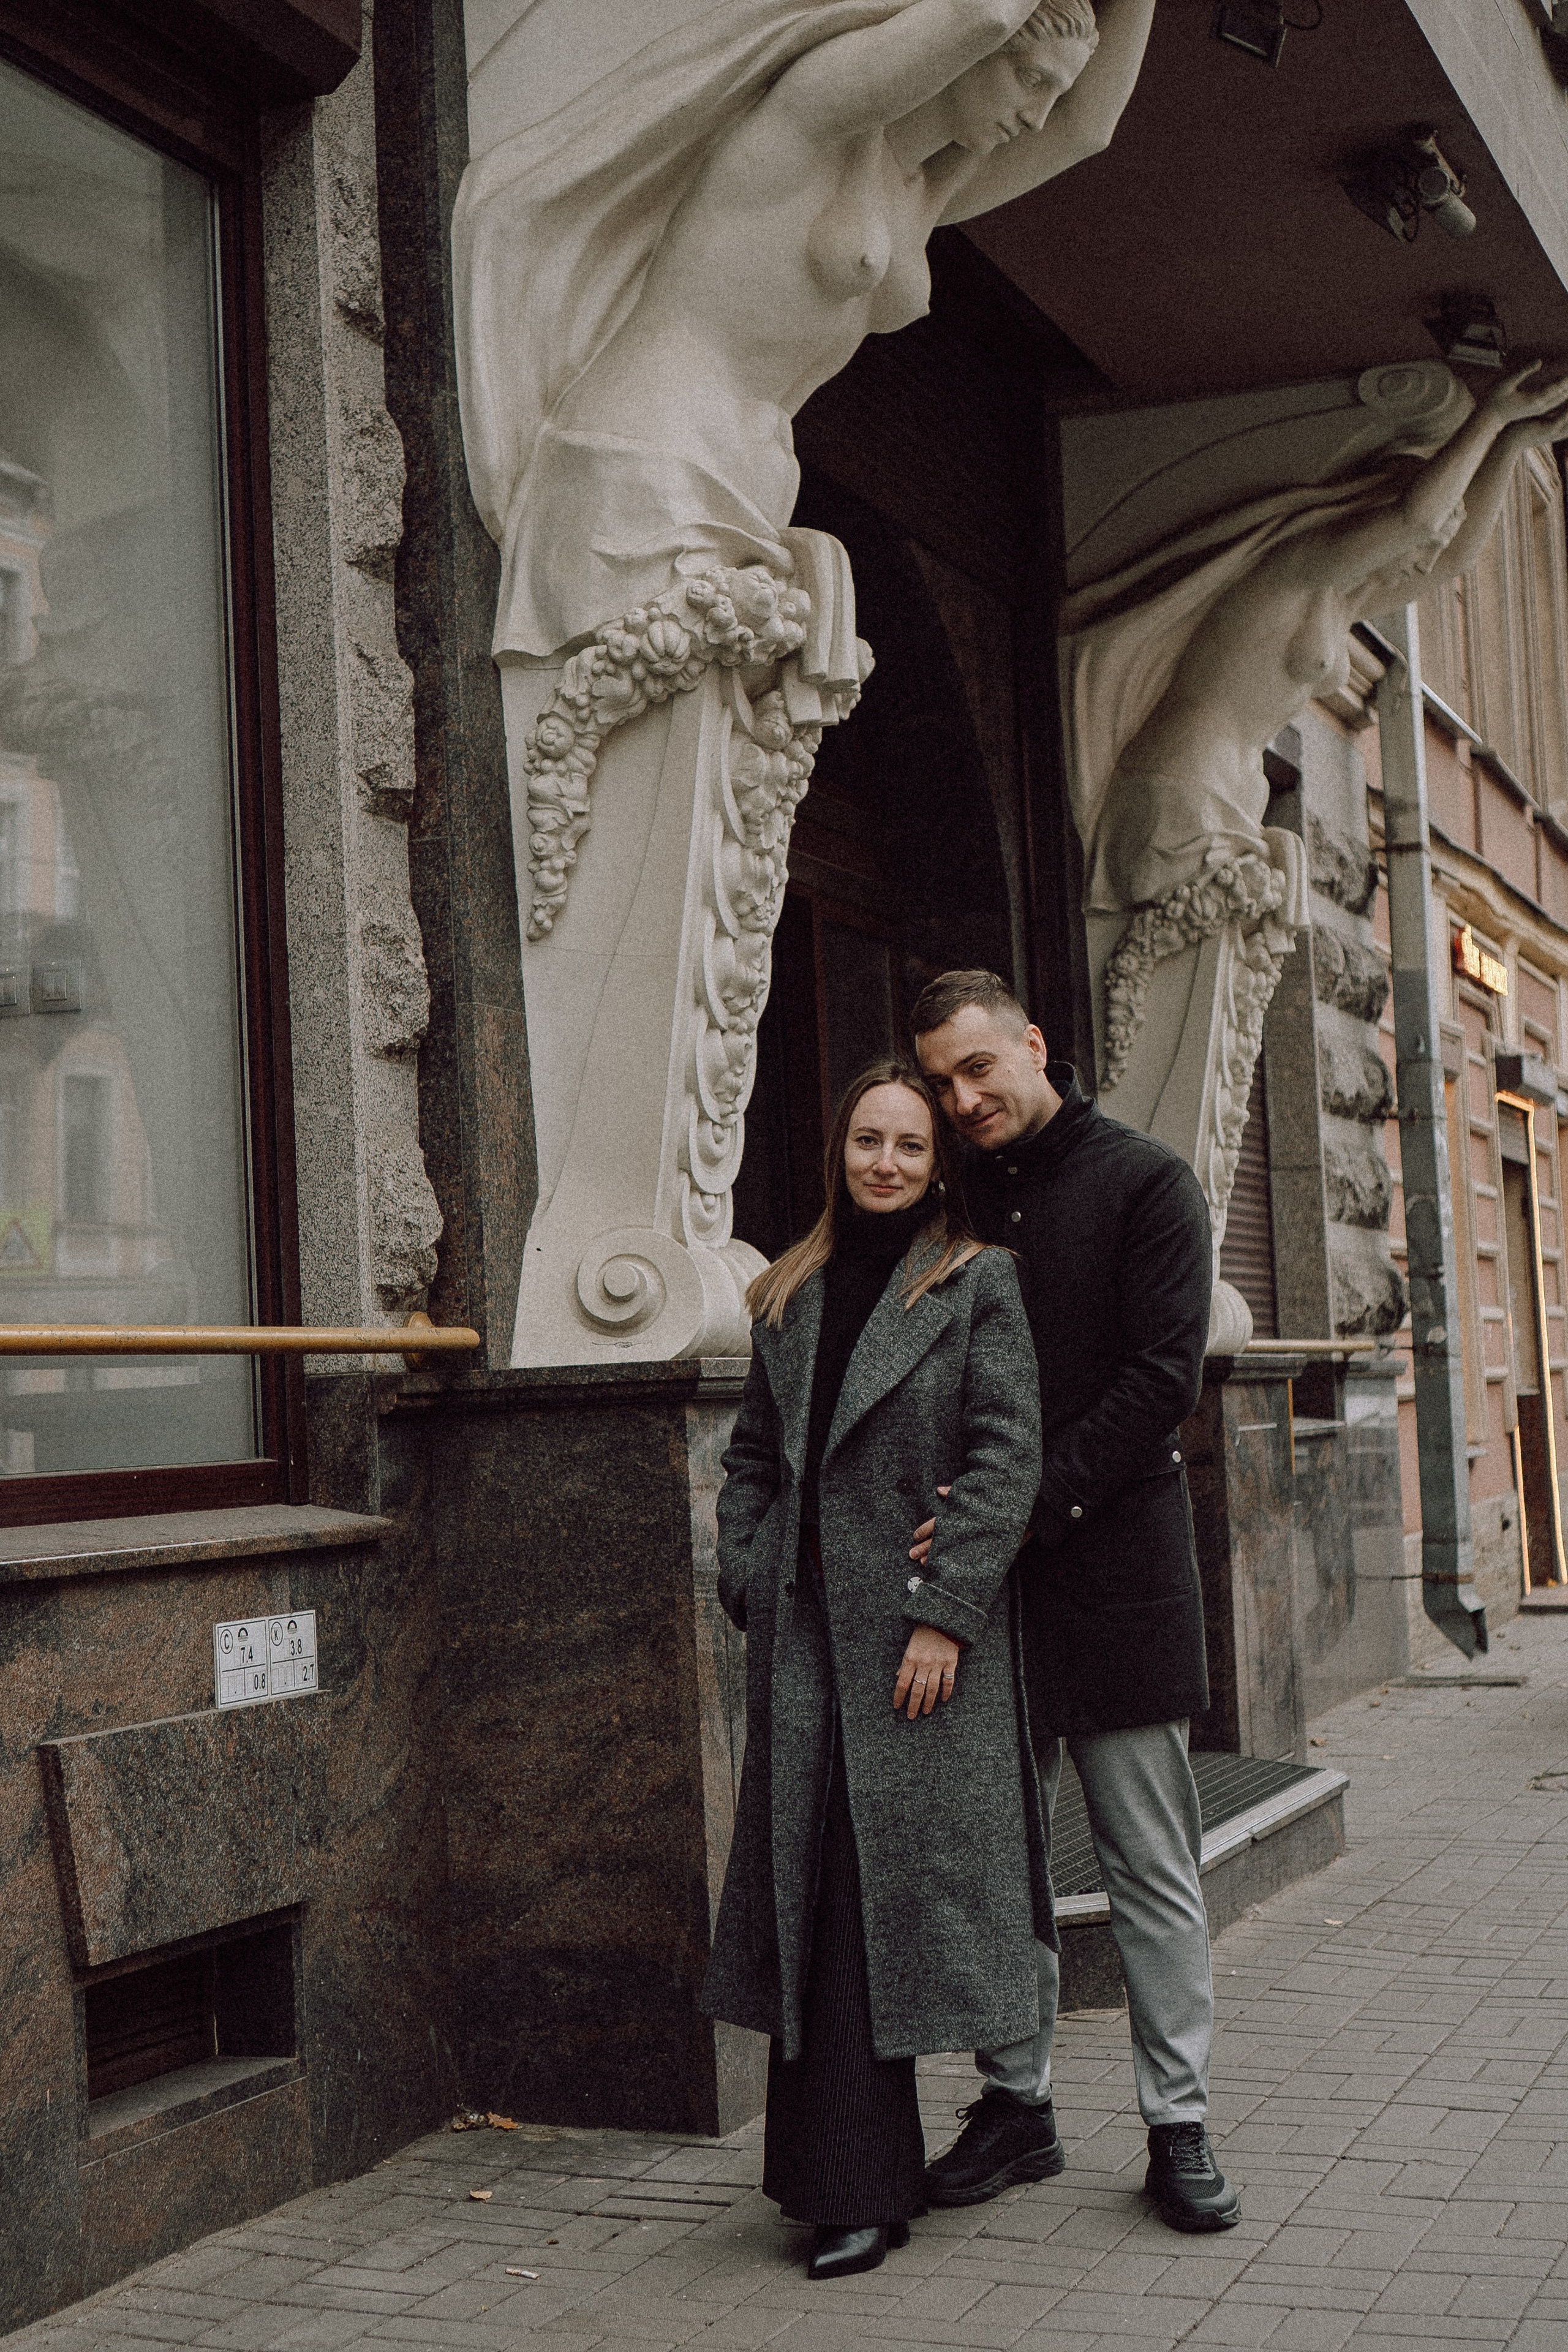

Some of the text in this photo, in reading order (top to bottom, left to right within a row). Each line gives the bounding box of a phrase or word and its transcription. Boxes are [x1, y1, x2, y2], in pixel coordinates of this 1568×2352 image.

[224, 1634, 230, 1650] C
[290, 1638, 303, 1656] 3.8
[303, 1664, 314, 1681] 2.7
[254, 1673, 266, 1691] 0.8
